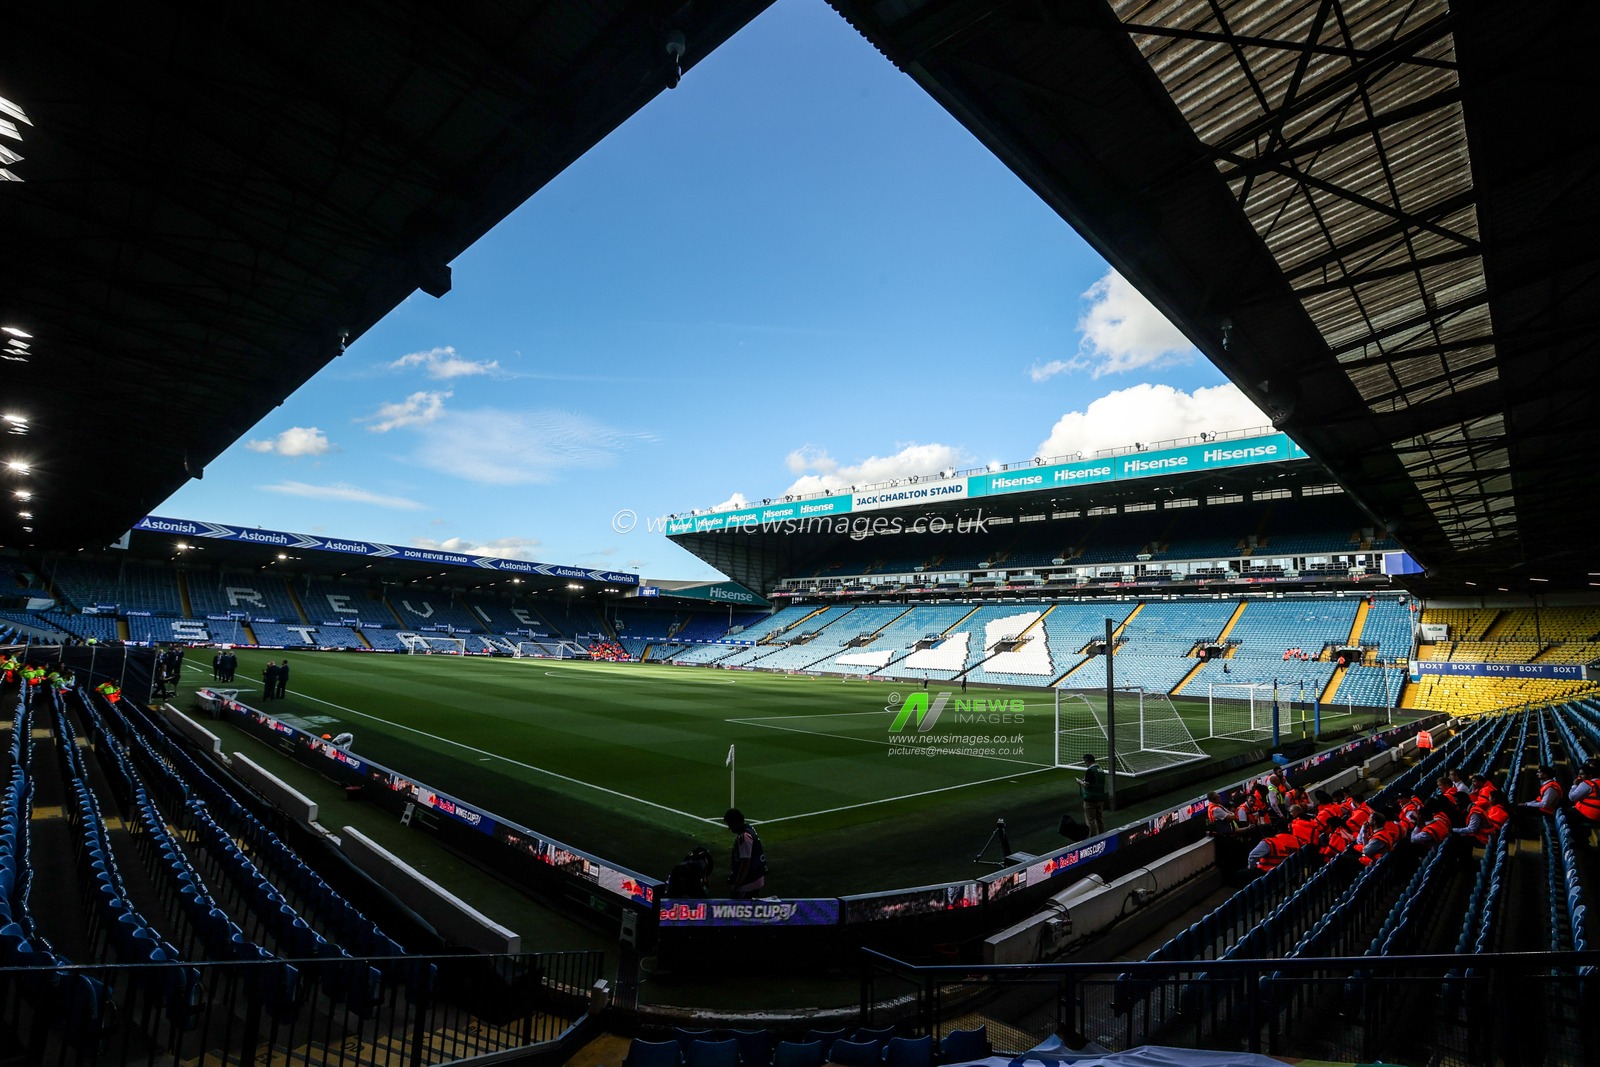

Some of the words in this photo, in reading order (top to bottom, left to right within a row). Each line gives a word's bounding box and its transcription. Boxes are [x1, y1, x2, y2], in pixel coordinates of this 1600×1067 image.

[1203, 443, 1277, 462] Hisense
[1123, 455, 1188, 472] Hisense
[1054, 465, 1111, 481] Hisense
[992, 473, 1043, 489] Hisense
[856, 495, 878, 505] JACK
[880, 490, 928, 503] CHARLTON
[930, 484, 963, 497] STAND
[763, 508, 793, 519] Hisense
[800, 503, 834, 514] Hisense
[728, 513, 757, 523] Hisense
[140, 517, 197, 534] Astonish
[239, 530, 288, 544] Astonish
[324, 539, 368, 553] Astonish
[404, 550, 421, 559] DON
[421, 552, 444, 561] REVIE
[444, 554, 468, 563] STAND
[499, 560, 532, 572] Astonish
[556, 566, 585, 578] Astonish
[607, 573, 634, 583] Astonish
[709, 587, 753, 602] Hisense
[1419, 663, 1443, 671] BOXT
[1486, 664, 1510, 672] BOXT
[1519, 665, 1543, 673] BOXT
[1553, 666, 1577, 674] BOXT
[712, 905, 753, 918] WINGS
[753, 905, 780, 918] CUP
